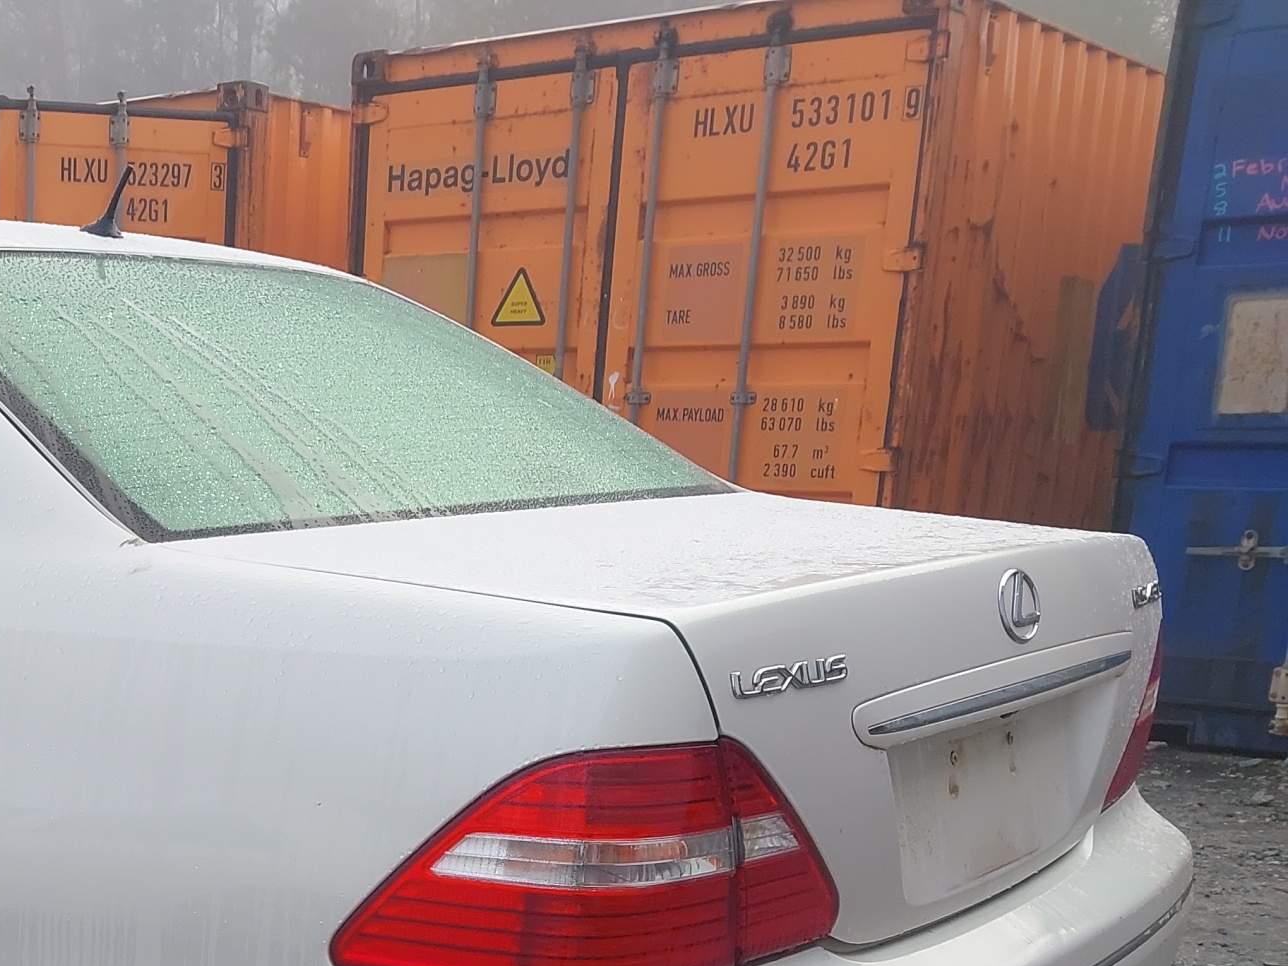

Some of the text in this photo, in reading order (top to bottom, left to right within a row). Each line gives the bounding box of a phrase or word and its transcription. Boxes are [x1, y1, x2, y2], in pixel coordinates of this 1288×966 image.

[694, 87, 921, 138] HLXU 533101 9
[787, 137, 853, 173] 42G1
[60, 156, 223, 189] HLXU 523297 3
[387, 148, 570, 197] Hapag-Lloyd
[125, 197, 169, 224] 42G1
[835, 245, 852, 264] kg
[669, 261, 731, 279] MAX GROSS
[832, 265, 854, 281] lbs
[829, 293, 846, 313] kg
[666, 309, 692, 326] TARE
[827, 313, 847, 329] lbs
[656, 407, 725, 423] MAX PAYLOAD
[817, 396, 834, 417] kg
[815, 416, 836, 432] lbs
[810, 463, 836, 480] cuft
[729, 653, 848, 699] LEXUS
